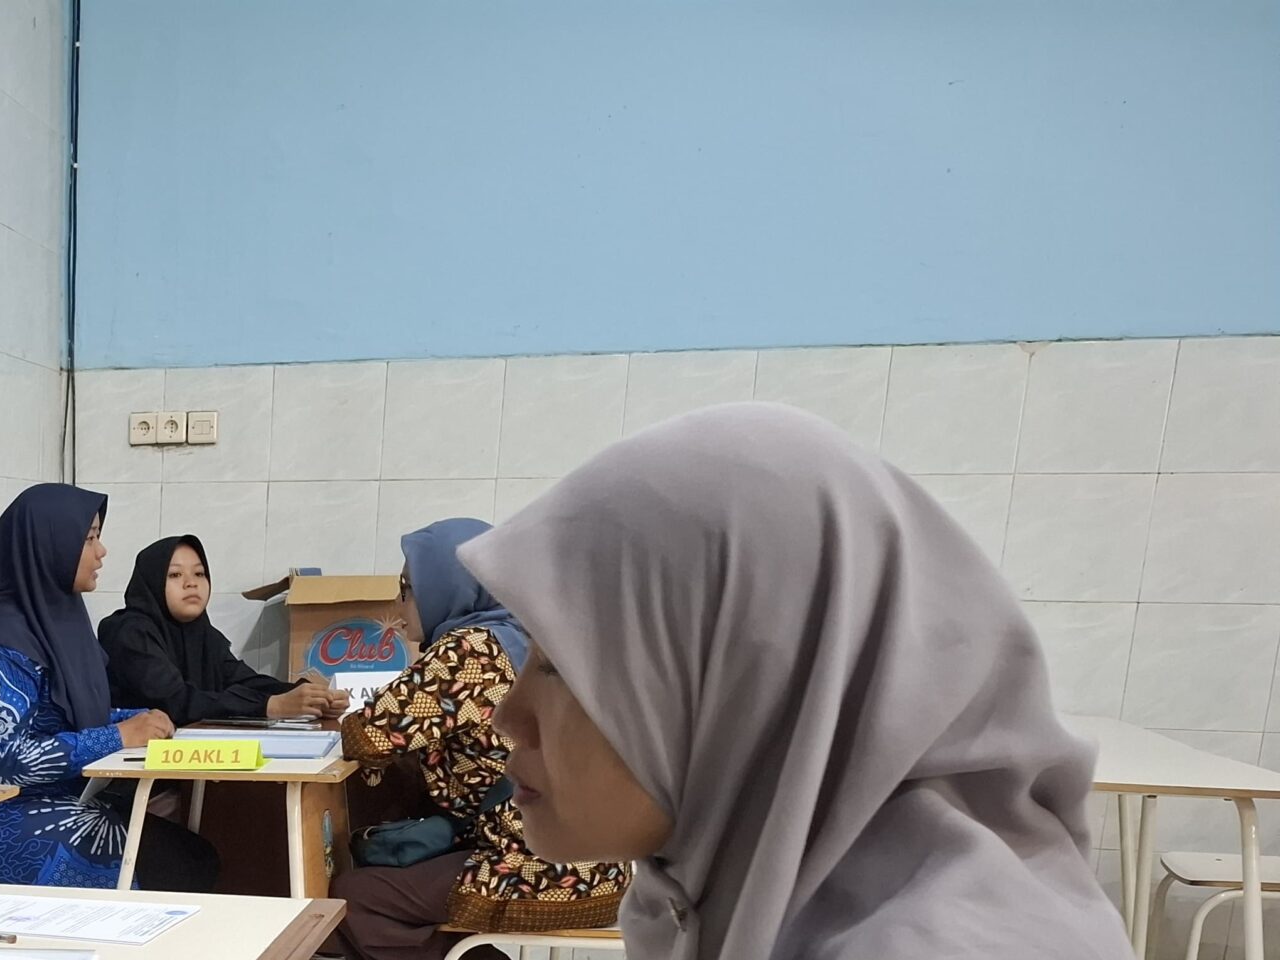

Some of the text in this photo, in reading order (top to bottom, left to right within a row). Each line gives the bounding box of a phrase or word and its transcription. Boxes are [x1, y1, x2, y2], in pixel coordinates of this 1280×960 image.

[319, 626, 396, 666] Club
[161, 749, 241, 764] 10 AKL 1
